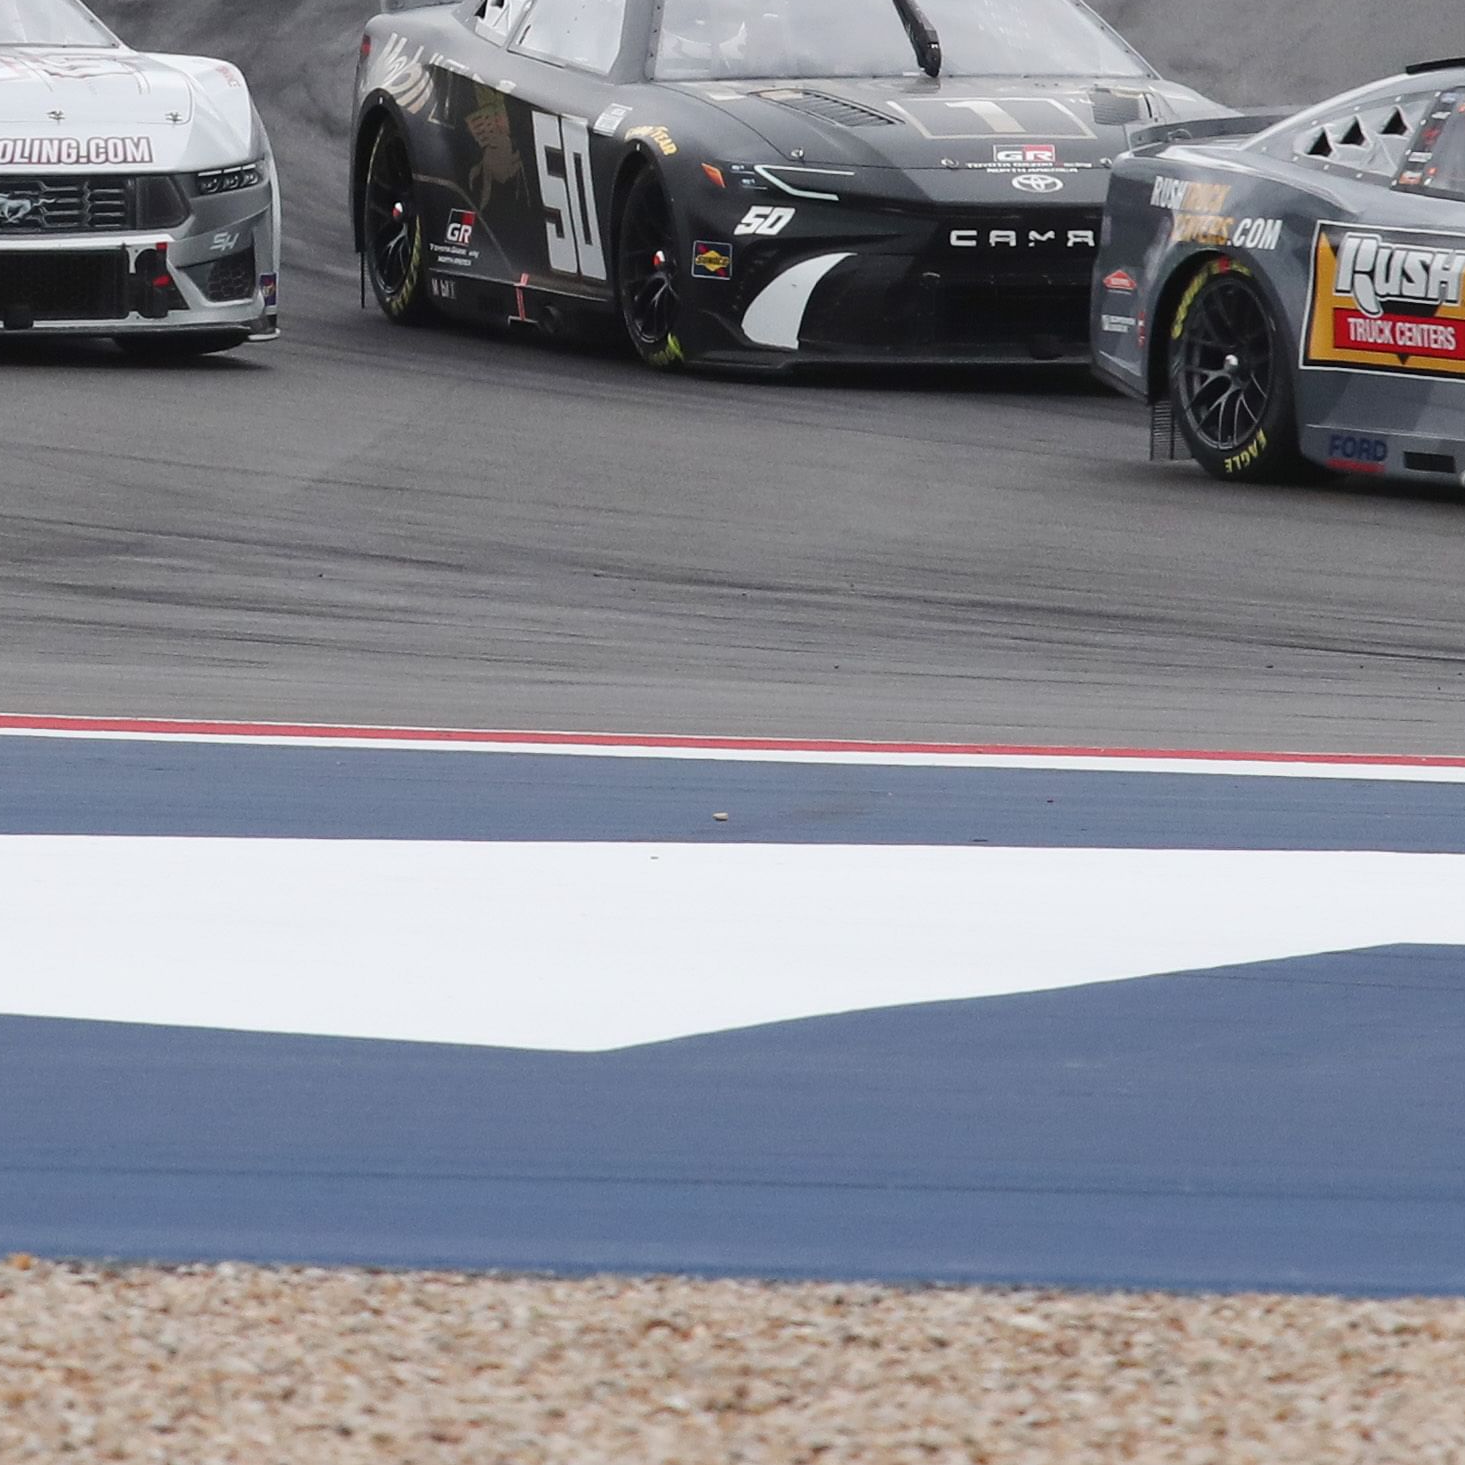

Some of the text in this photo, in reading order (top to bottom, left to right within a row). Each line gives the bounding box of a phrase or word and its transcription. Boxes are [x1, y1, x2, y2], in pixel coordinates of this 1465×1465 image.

[996, 150, 1053, 162] GR
[531, 110, 607, 282] 50
[446, 222, 473, 244] GR
[734, 205, 796, 236] 50
[1347, 317, 1456, 351] TRUCK CENTERS
[1327, 435, 1388, 463] FORD
